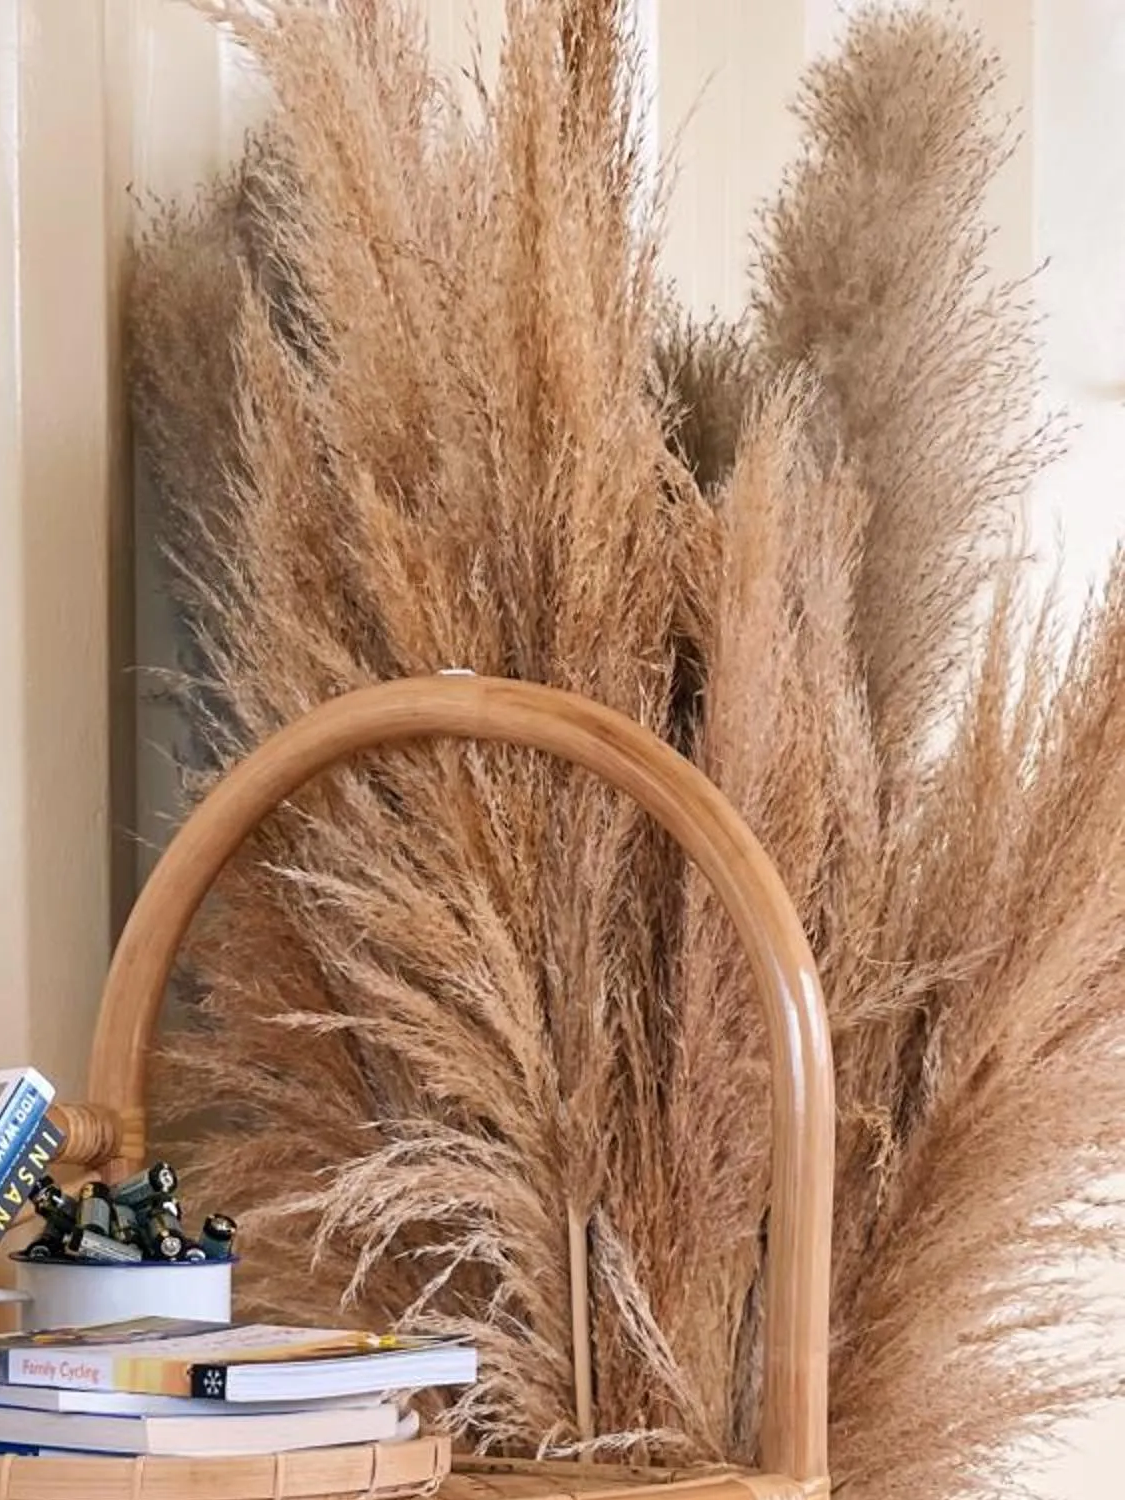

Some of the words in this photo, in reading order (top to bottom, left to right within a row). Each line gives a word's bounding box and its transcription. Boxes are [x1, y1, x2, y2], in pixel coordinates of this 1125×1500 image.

[13, 1092, 38, 1125] 100
[21, 1358, 56, 1381] Family
[58, 1361, 101, 1384] Cycling
